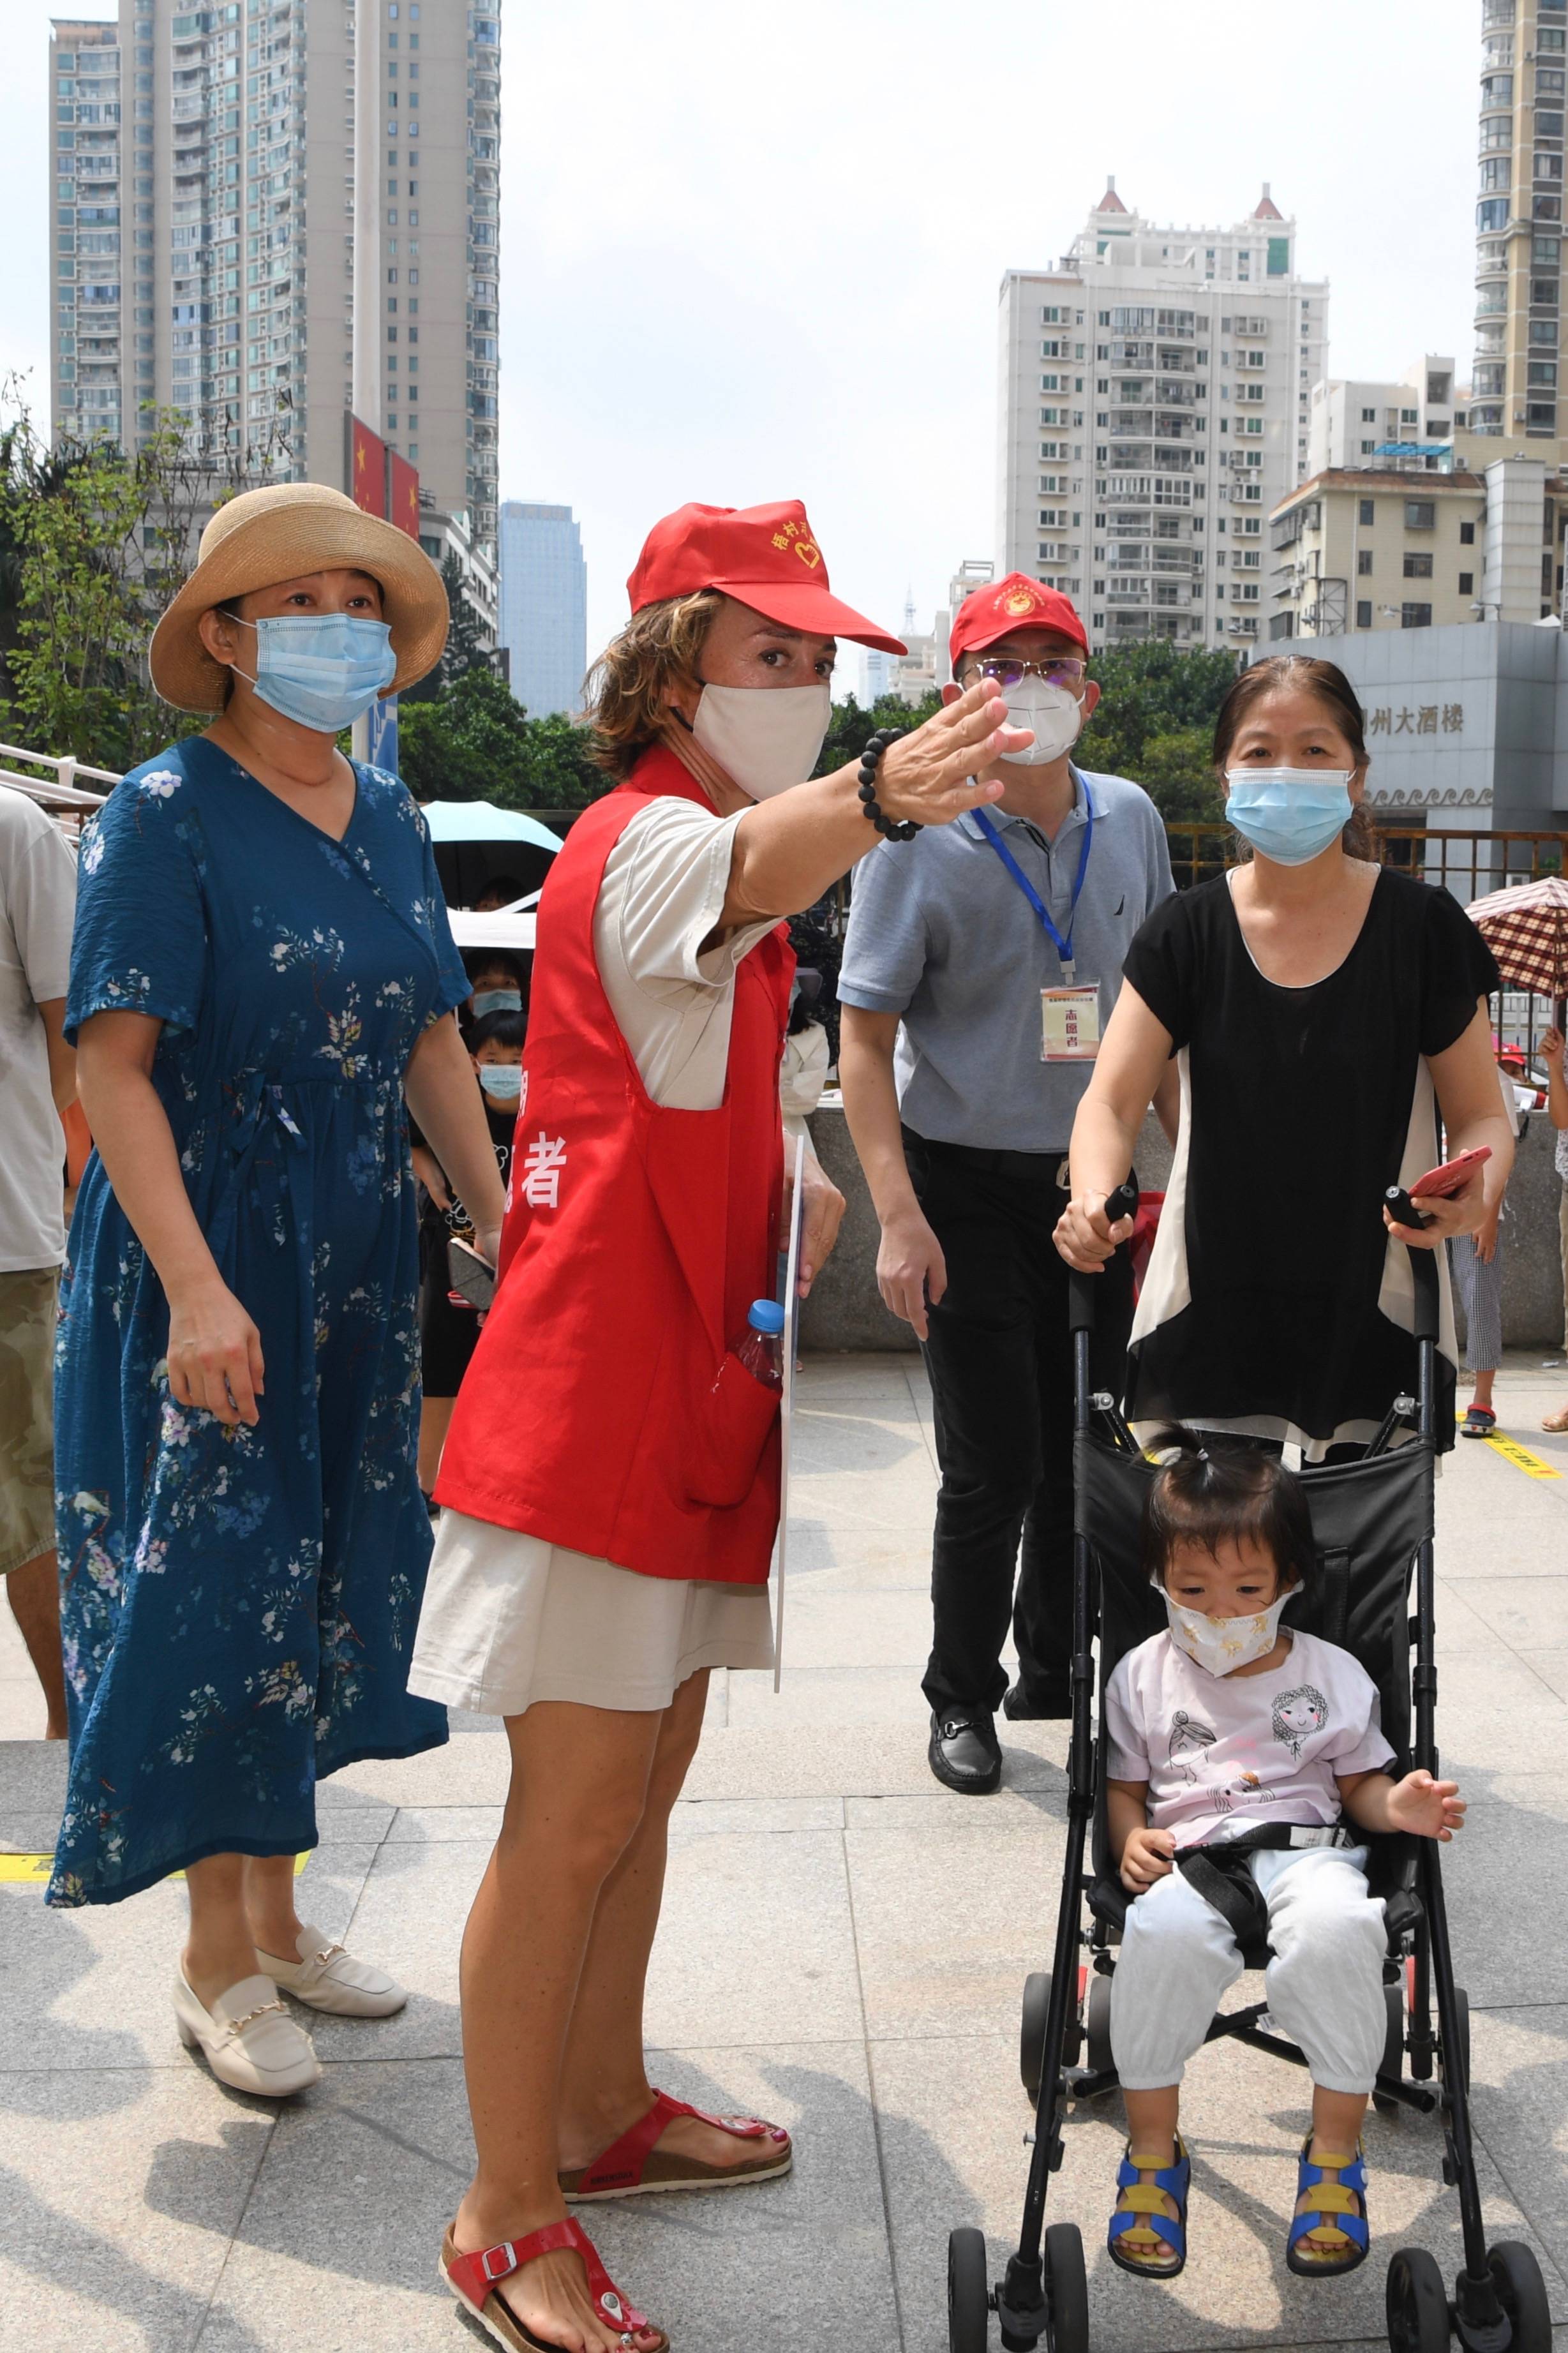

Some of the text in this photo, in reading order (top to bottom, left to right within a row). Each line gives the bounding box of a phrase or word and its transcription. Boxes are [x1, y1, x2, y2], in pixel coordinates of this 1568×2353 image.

[1065, 1009, 1078, 1047] 志愿者
[505, 1131, 567, 1213] 者
